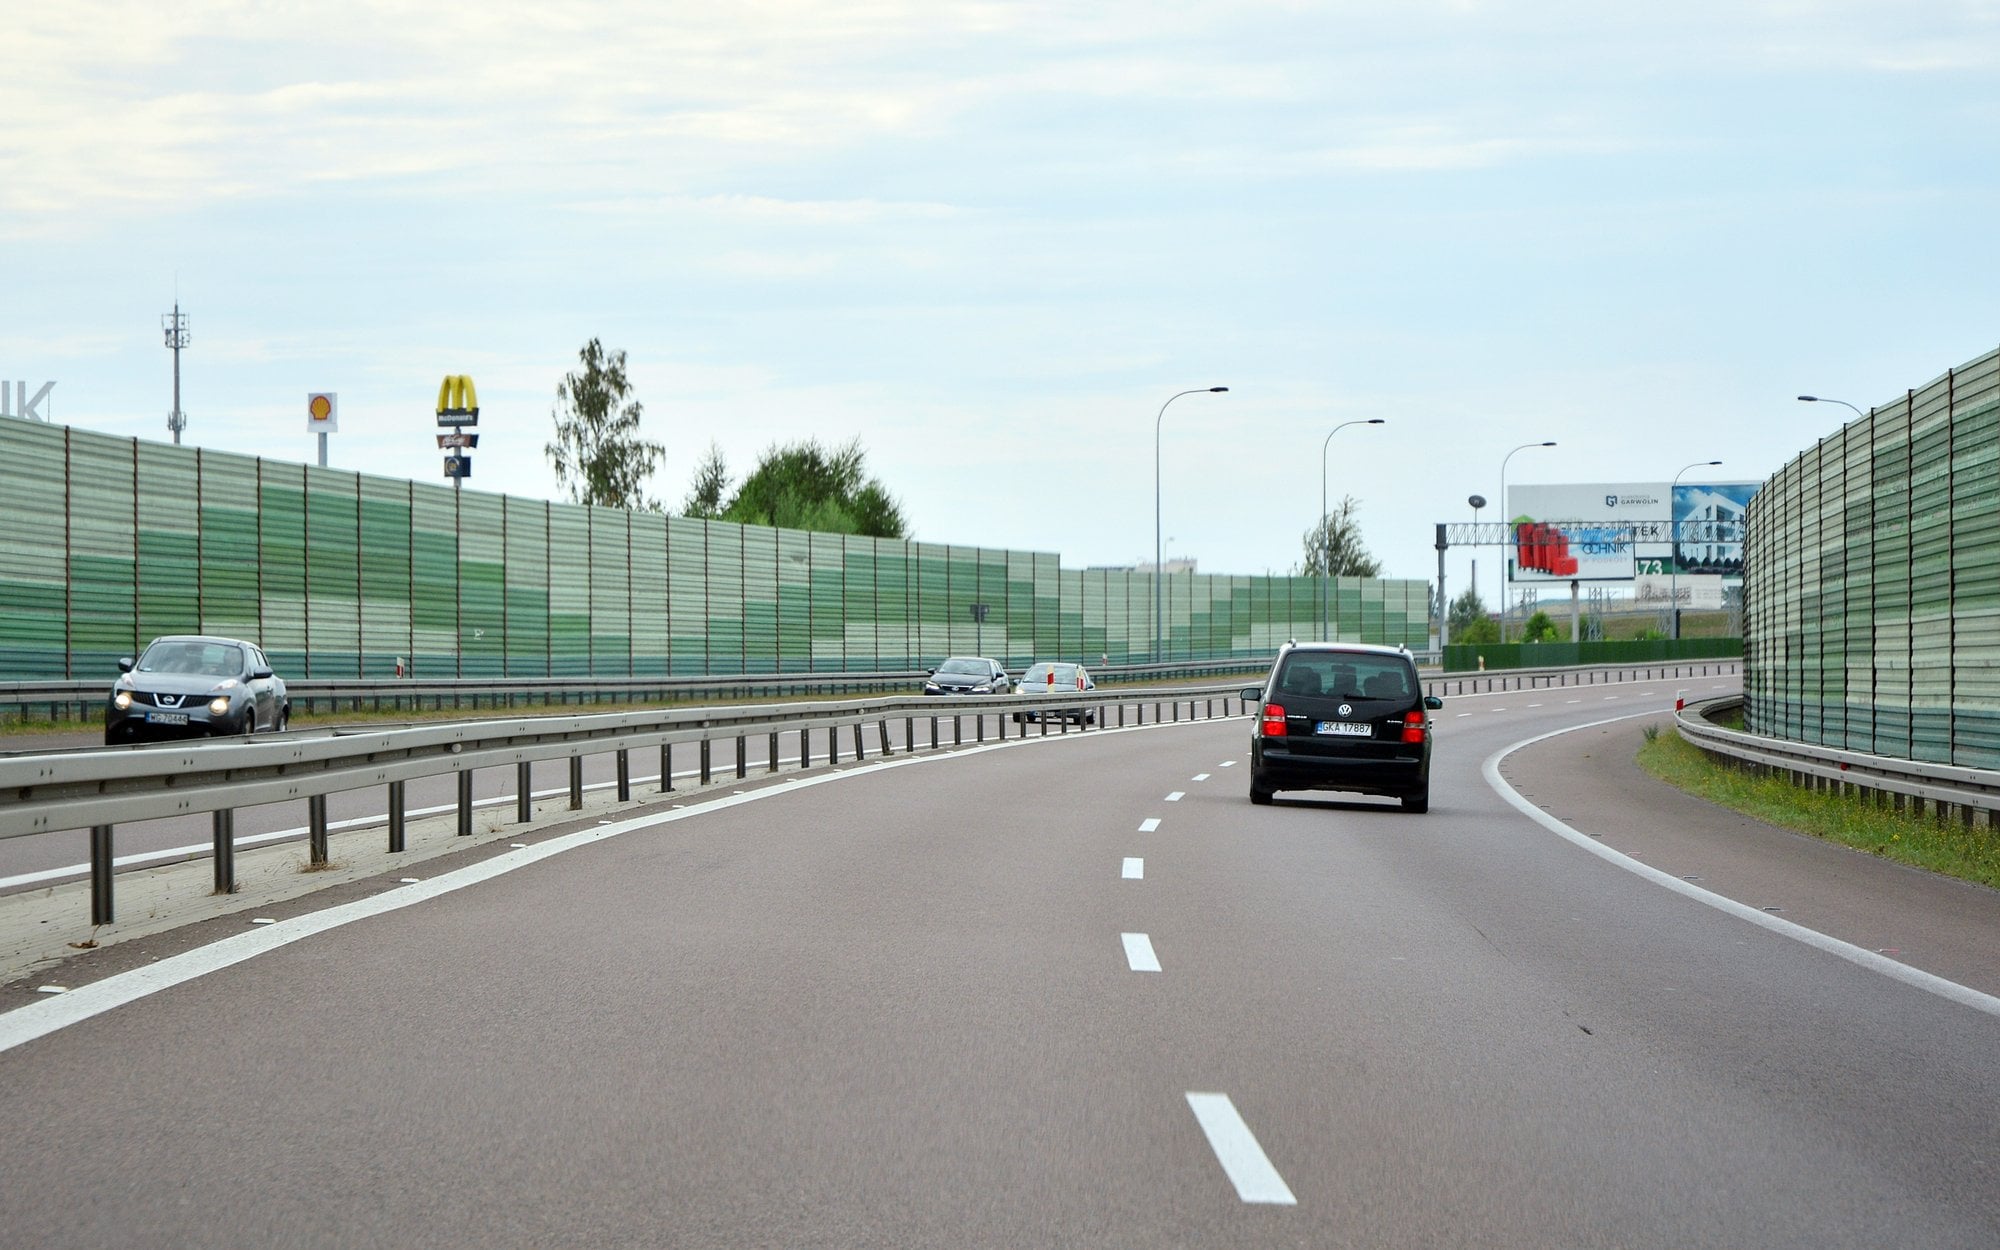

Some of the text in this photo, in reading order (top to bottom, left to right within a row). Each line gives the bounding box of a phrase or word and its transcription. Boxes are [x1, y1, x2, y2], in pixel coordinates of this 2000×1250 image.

[1582, 543, 1627, 554] OCHNIK
[1323, 722, 1370, 733] GKA 17887
